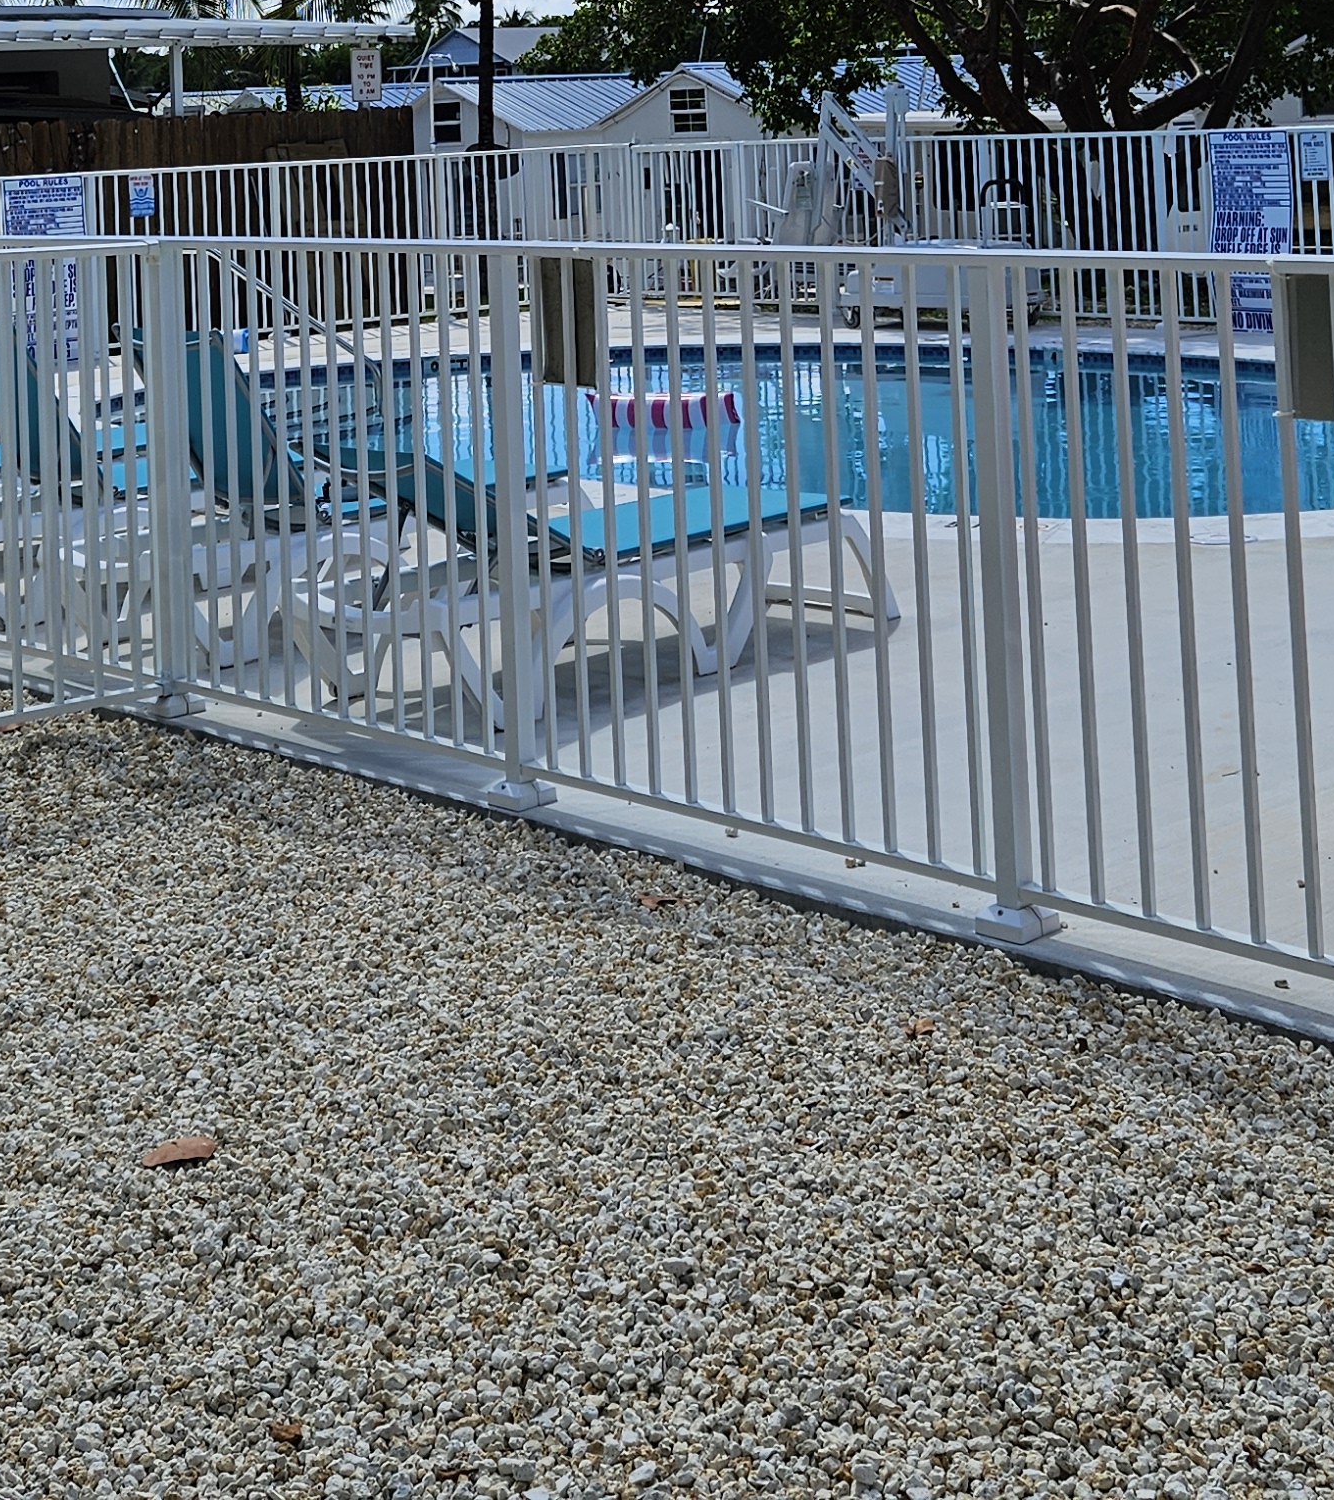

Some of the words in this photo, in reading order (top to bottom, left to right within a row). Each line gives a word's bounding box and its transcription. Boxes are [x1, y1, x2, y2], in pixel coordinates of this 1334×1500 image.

[1223, 132, 1244, 141] POOL
[1246, 132, 1272, 141] RULES
[19, 180, 40, 188] POOL
[43, 178, 69, 186] RULES
[1216, 211, 1265, 227] WARNING:
[1215, 227, 1239, 243] DROP
[1240, 227, 1256, 243] OFF
[1257, 227, 1269, 243] AT
[1269, 227, 1288, 243] SUN
[1232, 312, 1244, 329] NO
[1245, 312, 1273, 330] DIVIN
